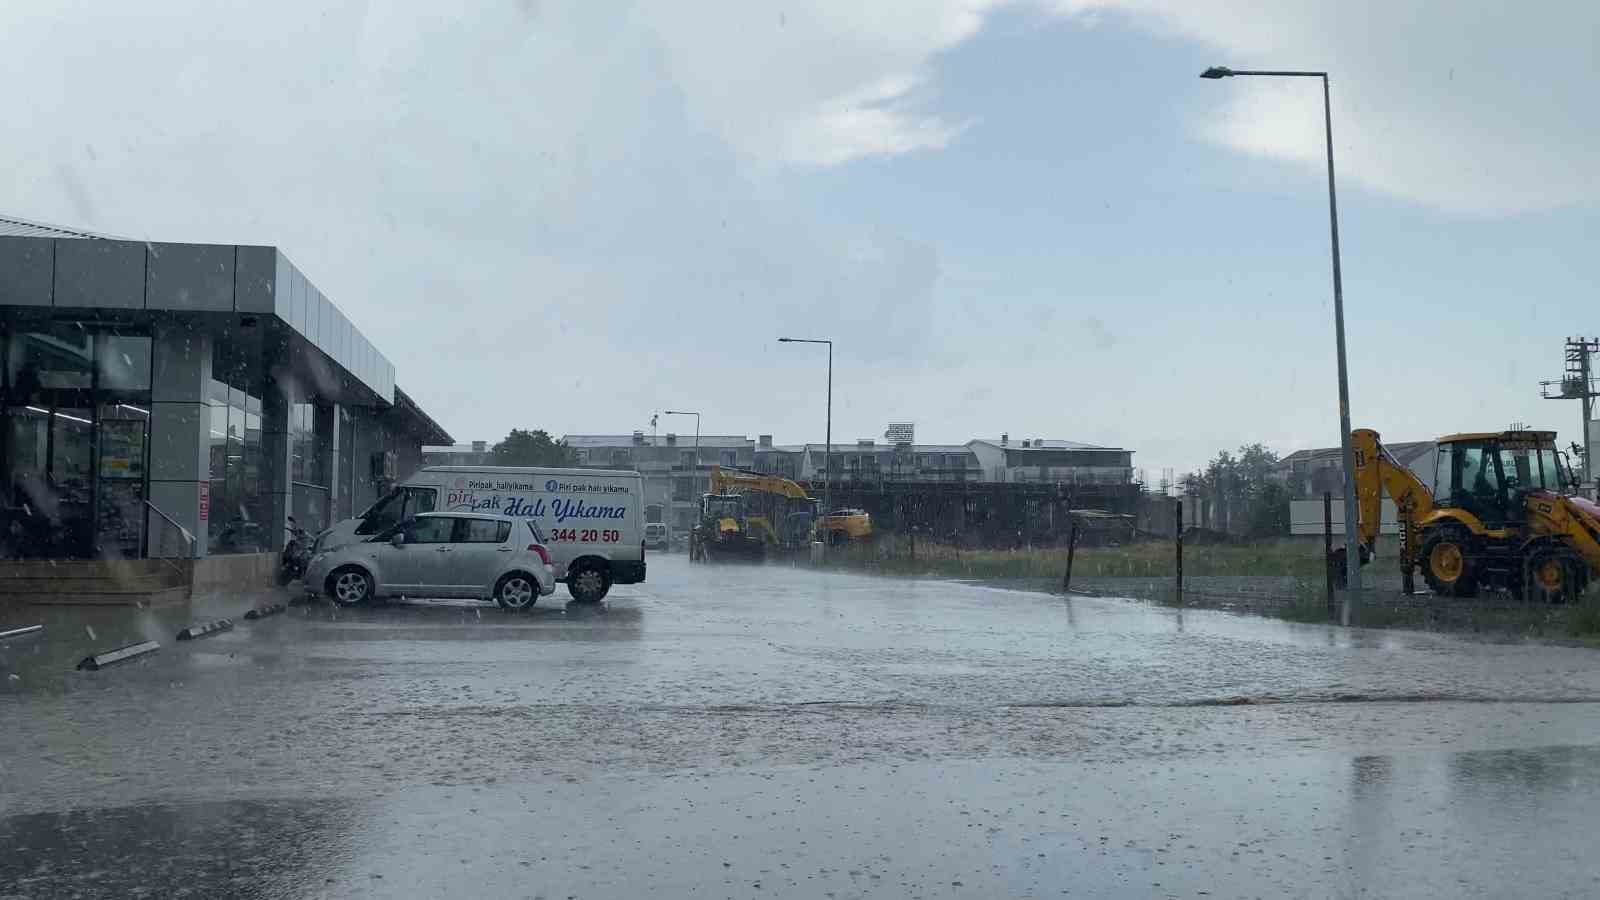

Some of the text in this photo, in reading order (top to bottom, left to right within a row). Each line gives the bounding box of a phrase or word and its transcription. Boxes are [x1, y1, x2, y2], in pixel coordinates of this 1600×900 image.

[551, 498, 626, 523] Yıkama
[551, 528, 620, 542] 344 20 50
